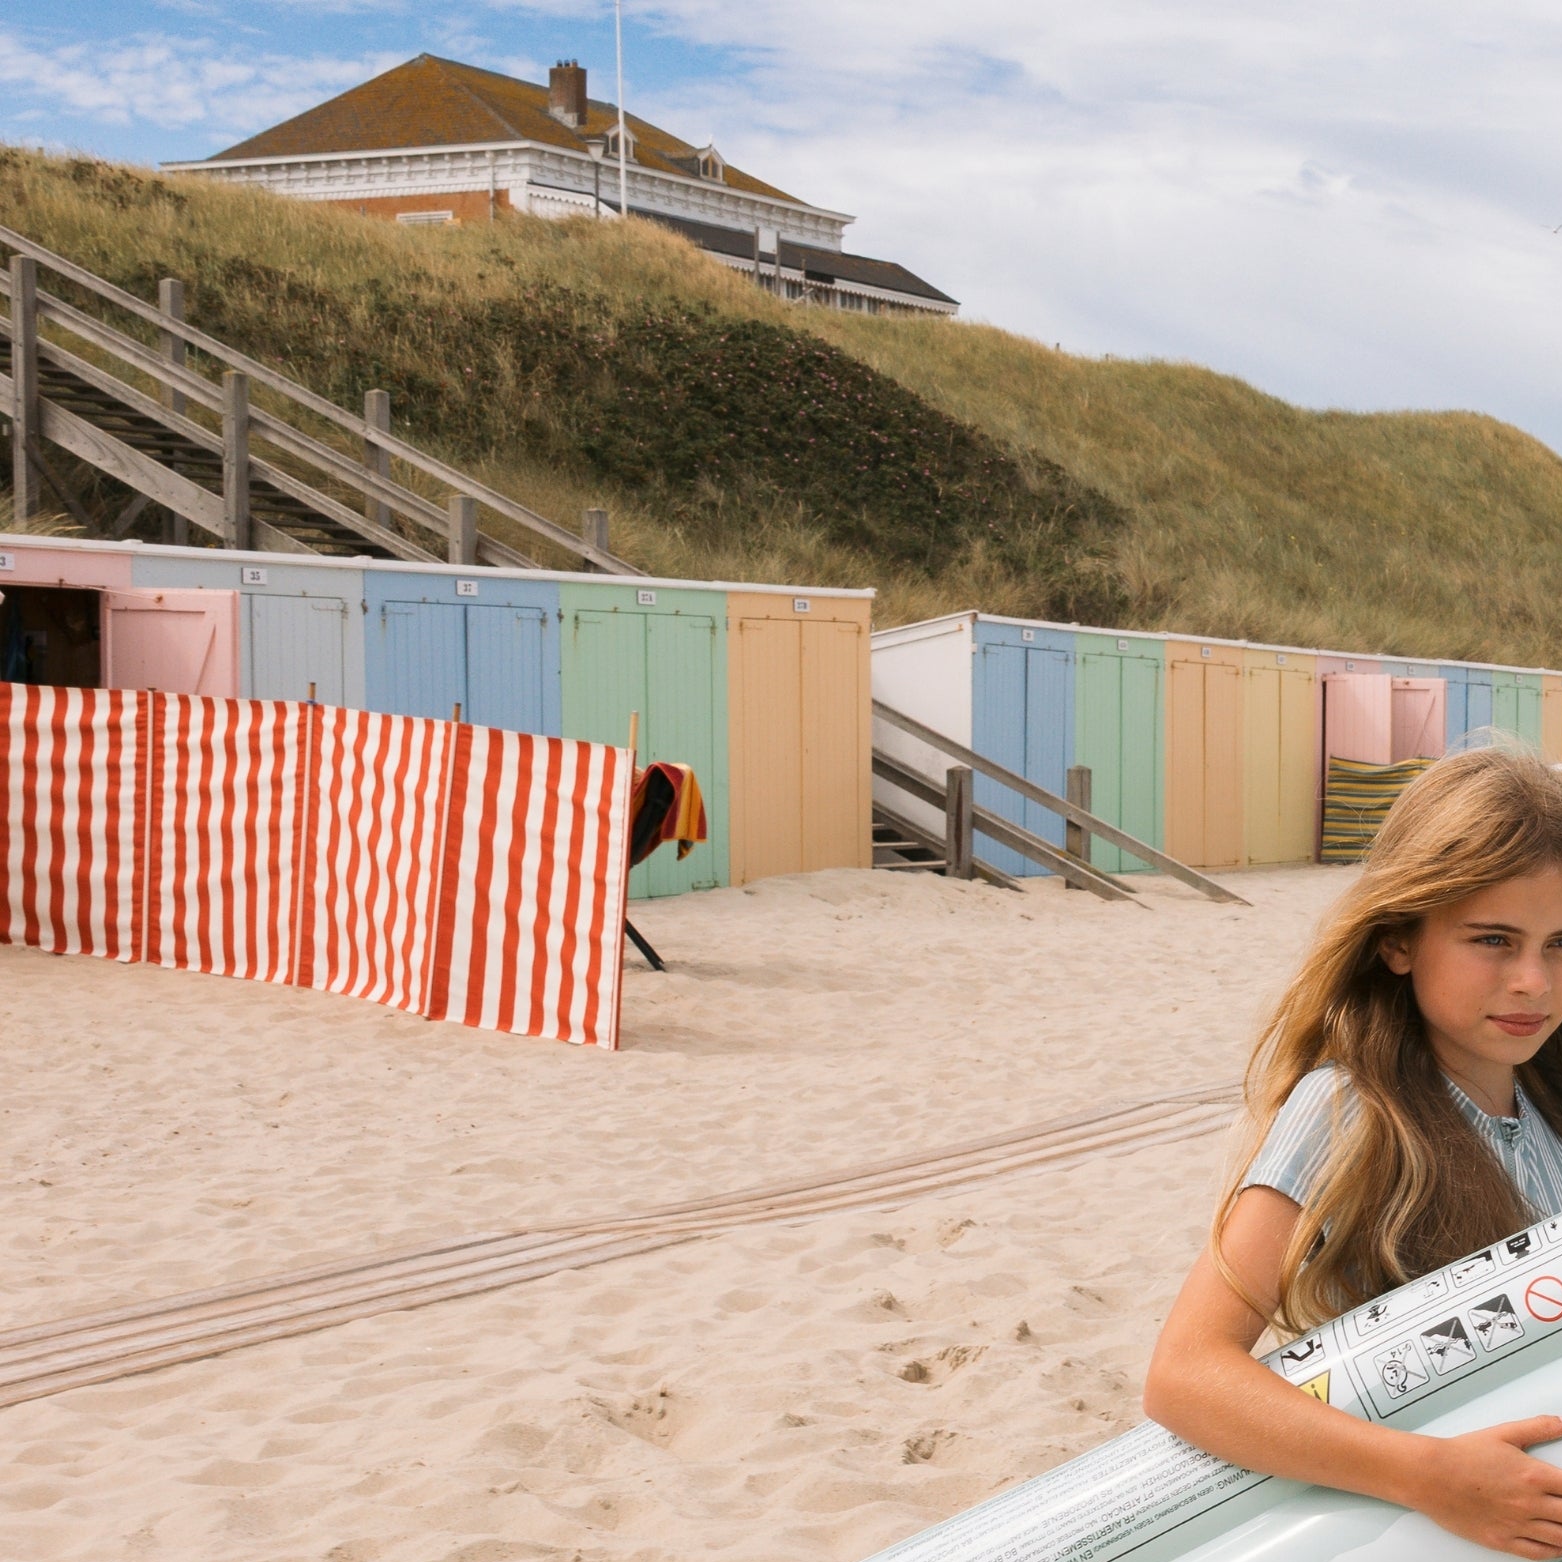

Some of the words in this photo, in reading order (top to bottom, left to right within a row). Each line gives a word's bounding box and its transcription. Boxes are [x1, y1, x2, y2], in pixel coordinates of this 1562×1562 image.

[1388, 1341, 1412, 1359] 0-14
[1141, 1489, 1155, 1501] PT
[1121, 1512, 1136, 1525] FR
[1078, 1549, 1093, 1562] EN
